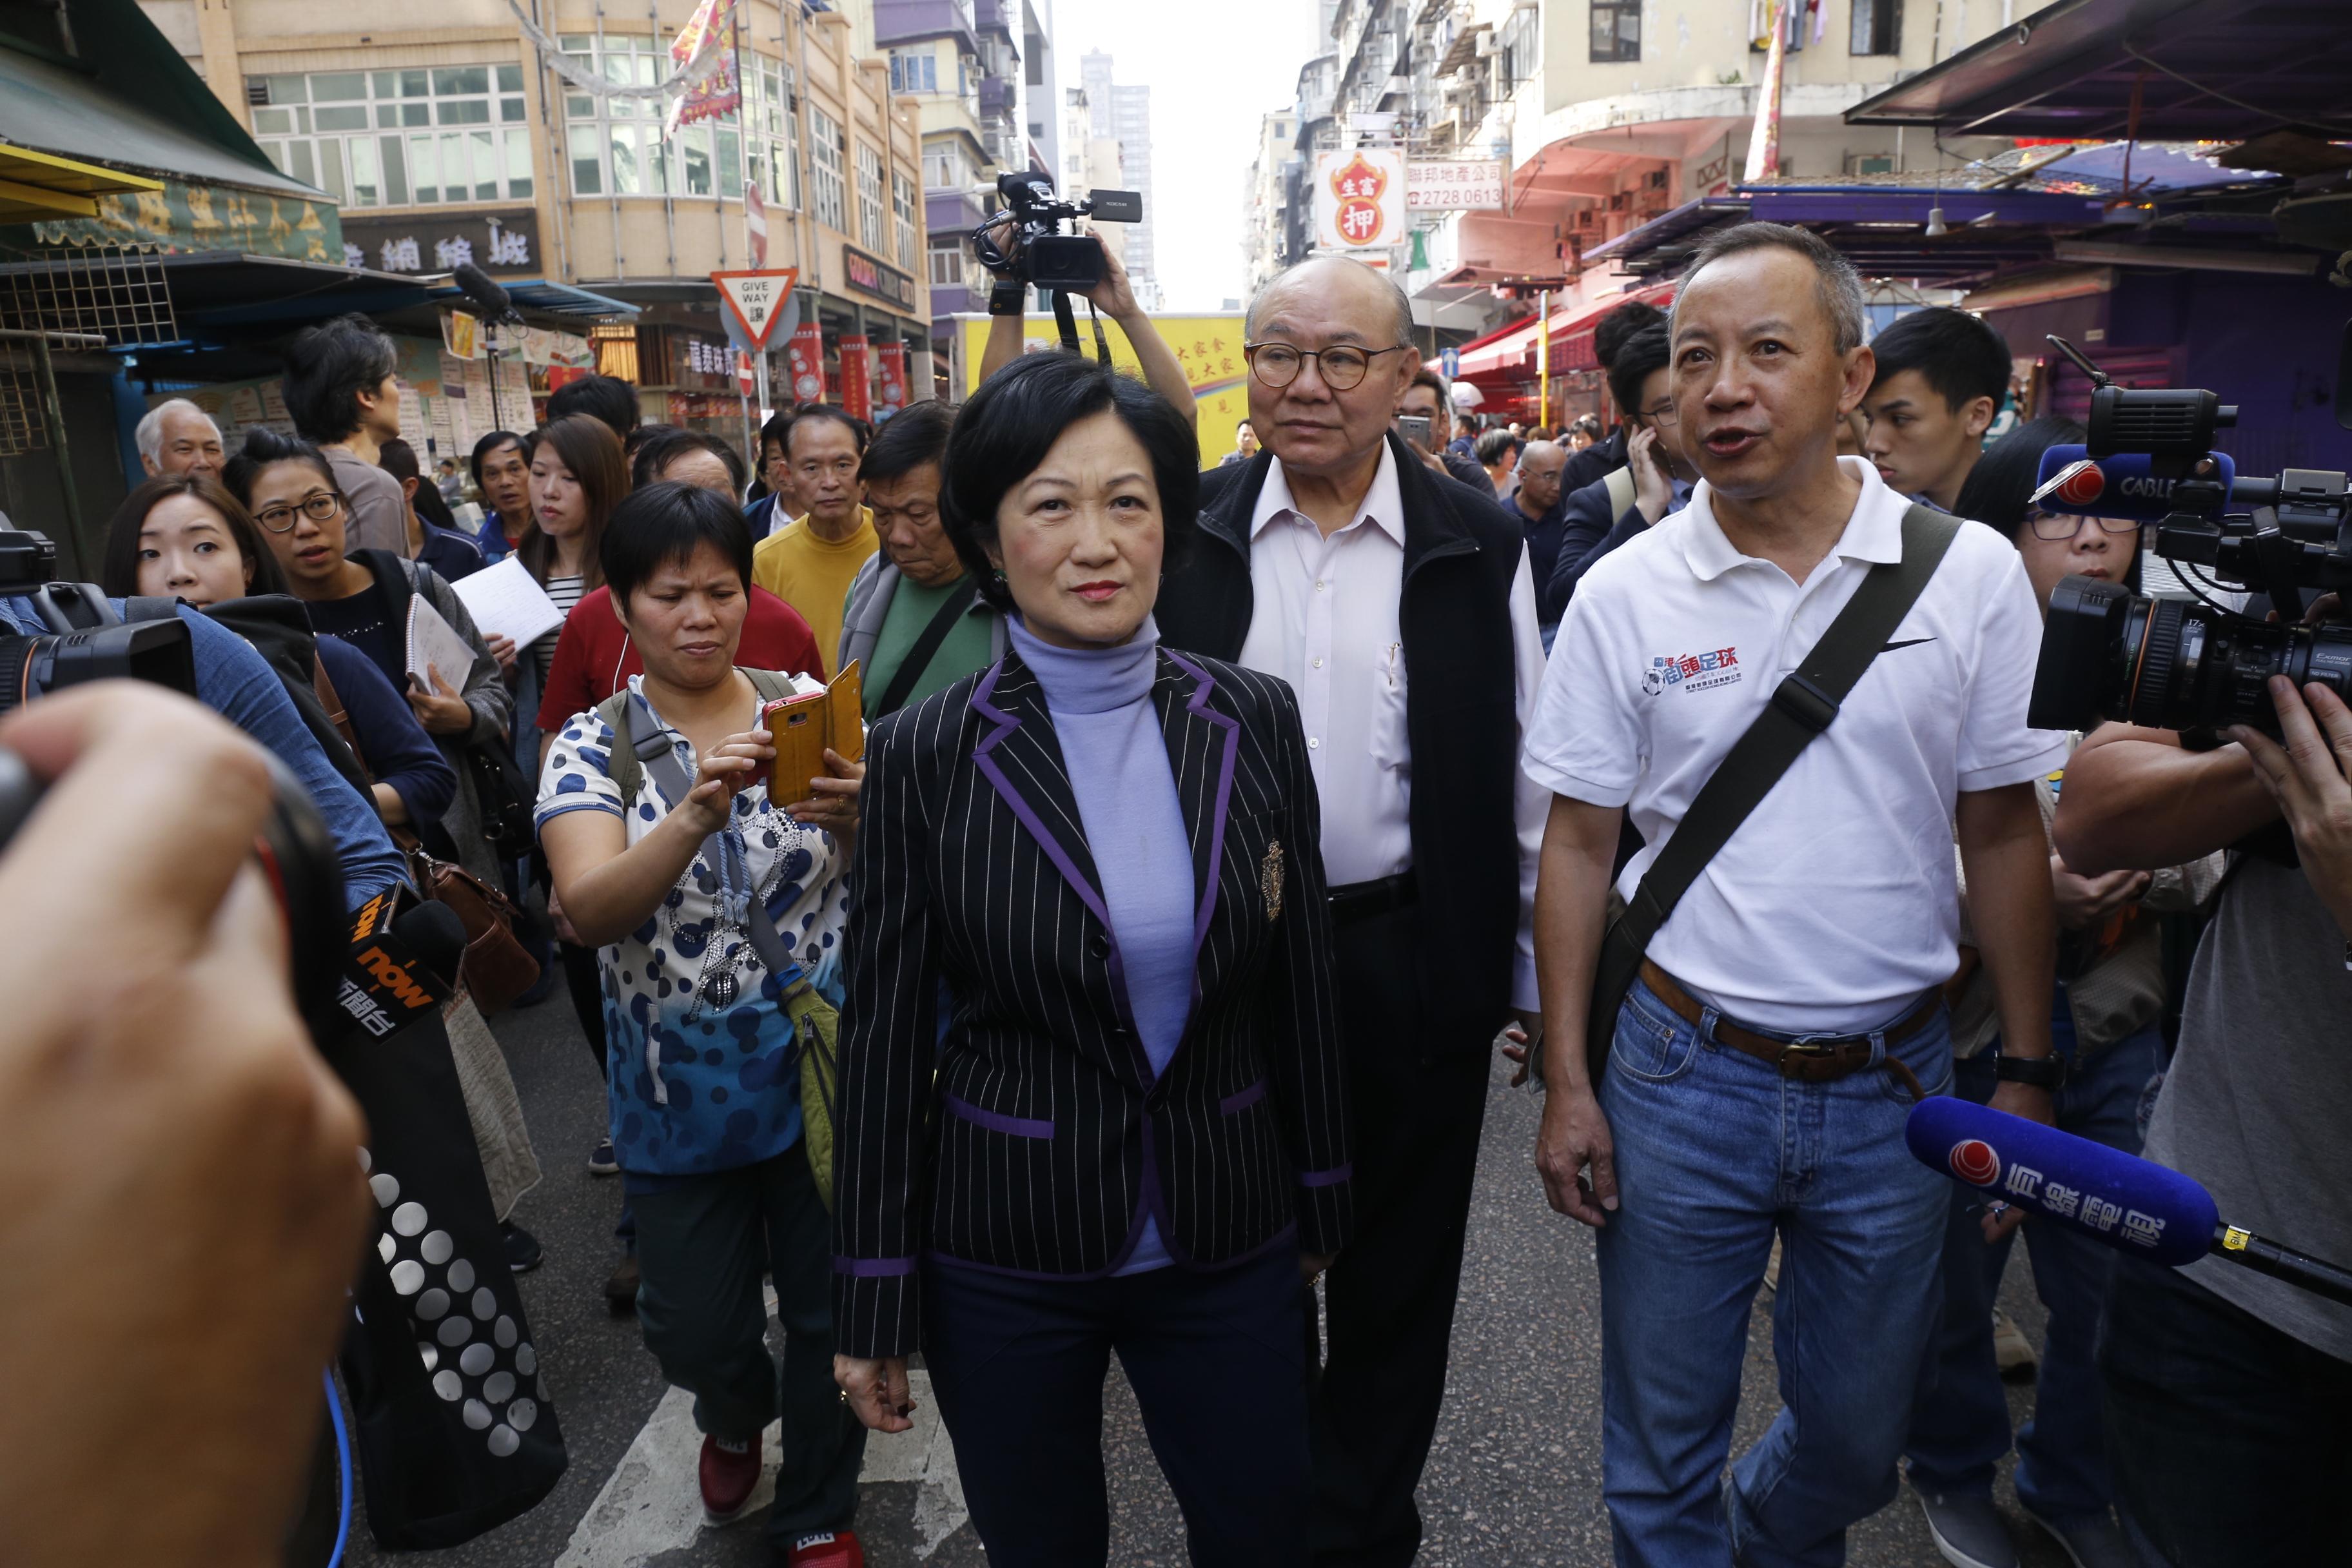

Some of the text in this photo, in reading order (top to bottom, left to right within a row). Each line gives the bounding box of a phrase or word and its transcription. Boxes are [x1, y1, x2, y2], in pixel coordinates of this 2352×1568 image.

[1407, 164, 1502, 183] 聯邦地產公司
[1424, 188, 1502, 205] 2728 0613
[1342, 205, 1375, 238] 押
[741, 282, 769, 291] GIVE
[742, 293, 769, 302] WAY
[2120, 476, 2177, 498] CABLE
[2316, 652, 2352, 662] Exmor
[351, 894, 384, 943] now
[356, 945, 434, 1009] now
[2004, 1162, 2166, 1248] 有線電視
